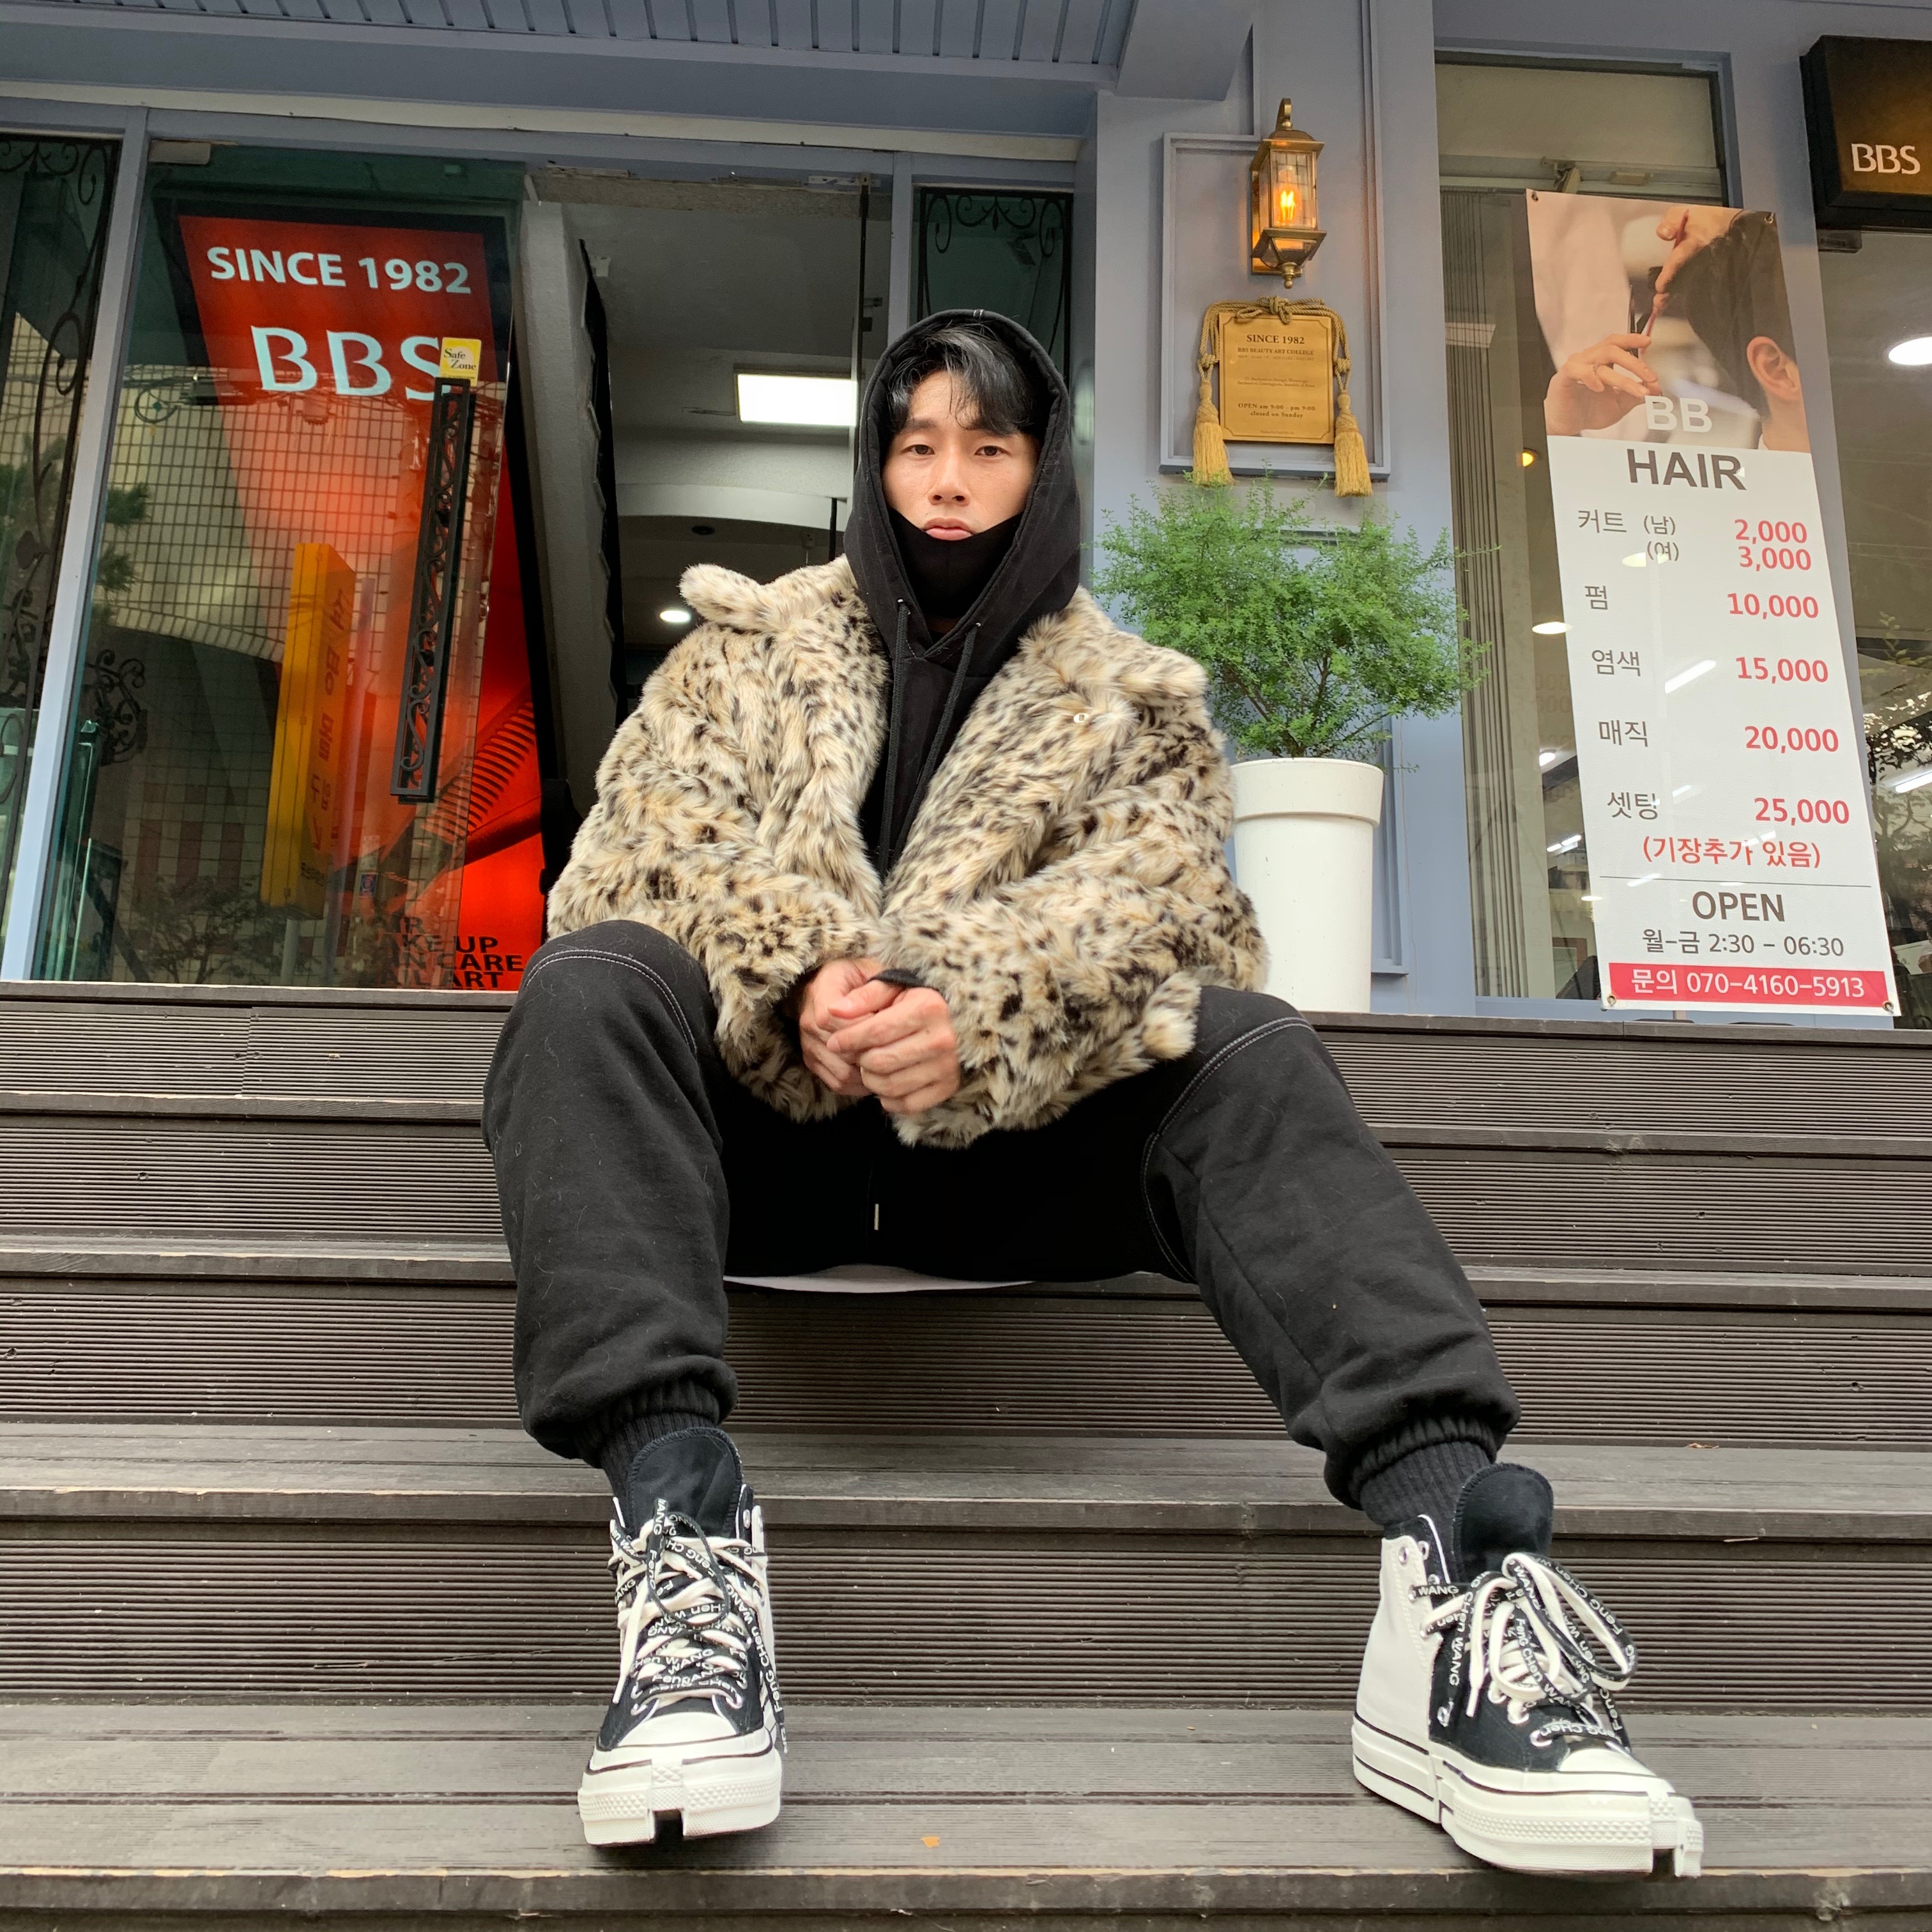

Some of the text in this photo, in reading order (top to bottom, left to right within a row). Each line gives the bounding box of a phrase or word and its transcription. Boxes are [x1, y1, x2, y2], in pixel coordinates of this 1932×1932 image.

[1851, 142, 1921, 175] BBS
[206, 246, 471, 295] SINCE 1982
[443, 348, 466, 359] Safe
[1246, 334, 1305, 344] SINCE 1982
[250, 325, 452, 401] BBS
[450, 359, 477, 370] Zone
[1644, 395, 1713, 433] BB
[1627, 448, 1747, 491] HAIR
[1578, 509, 1807, 545] 커트 (남) 2,000
[1647, 540, 1812, 572] (여) 3,000
[1584, 585, 1819, 620] 펌 10,000
[1591, 649, 1828, 684] 염색 15,000
[1598, 719, 1839, 754] 매직 20,000
[1607, 792, 1850, 826] 셋팅 25,000
[1643, 836, 1821, 869] (기장추가 있음)
[1692, 891, 1785, 921] OPEN
[454, 936, 498, 953] UP
[1708, 933, 1754, 954] 2:30
[1784, 935, 1844, 956] 06:30
[437, 953, 524, 972] CARE
[439, 970, 503, 988] ART
[1631, 969, 1865, 998] 문의 070-4160-5913
